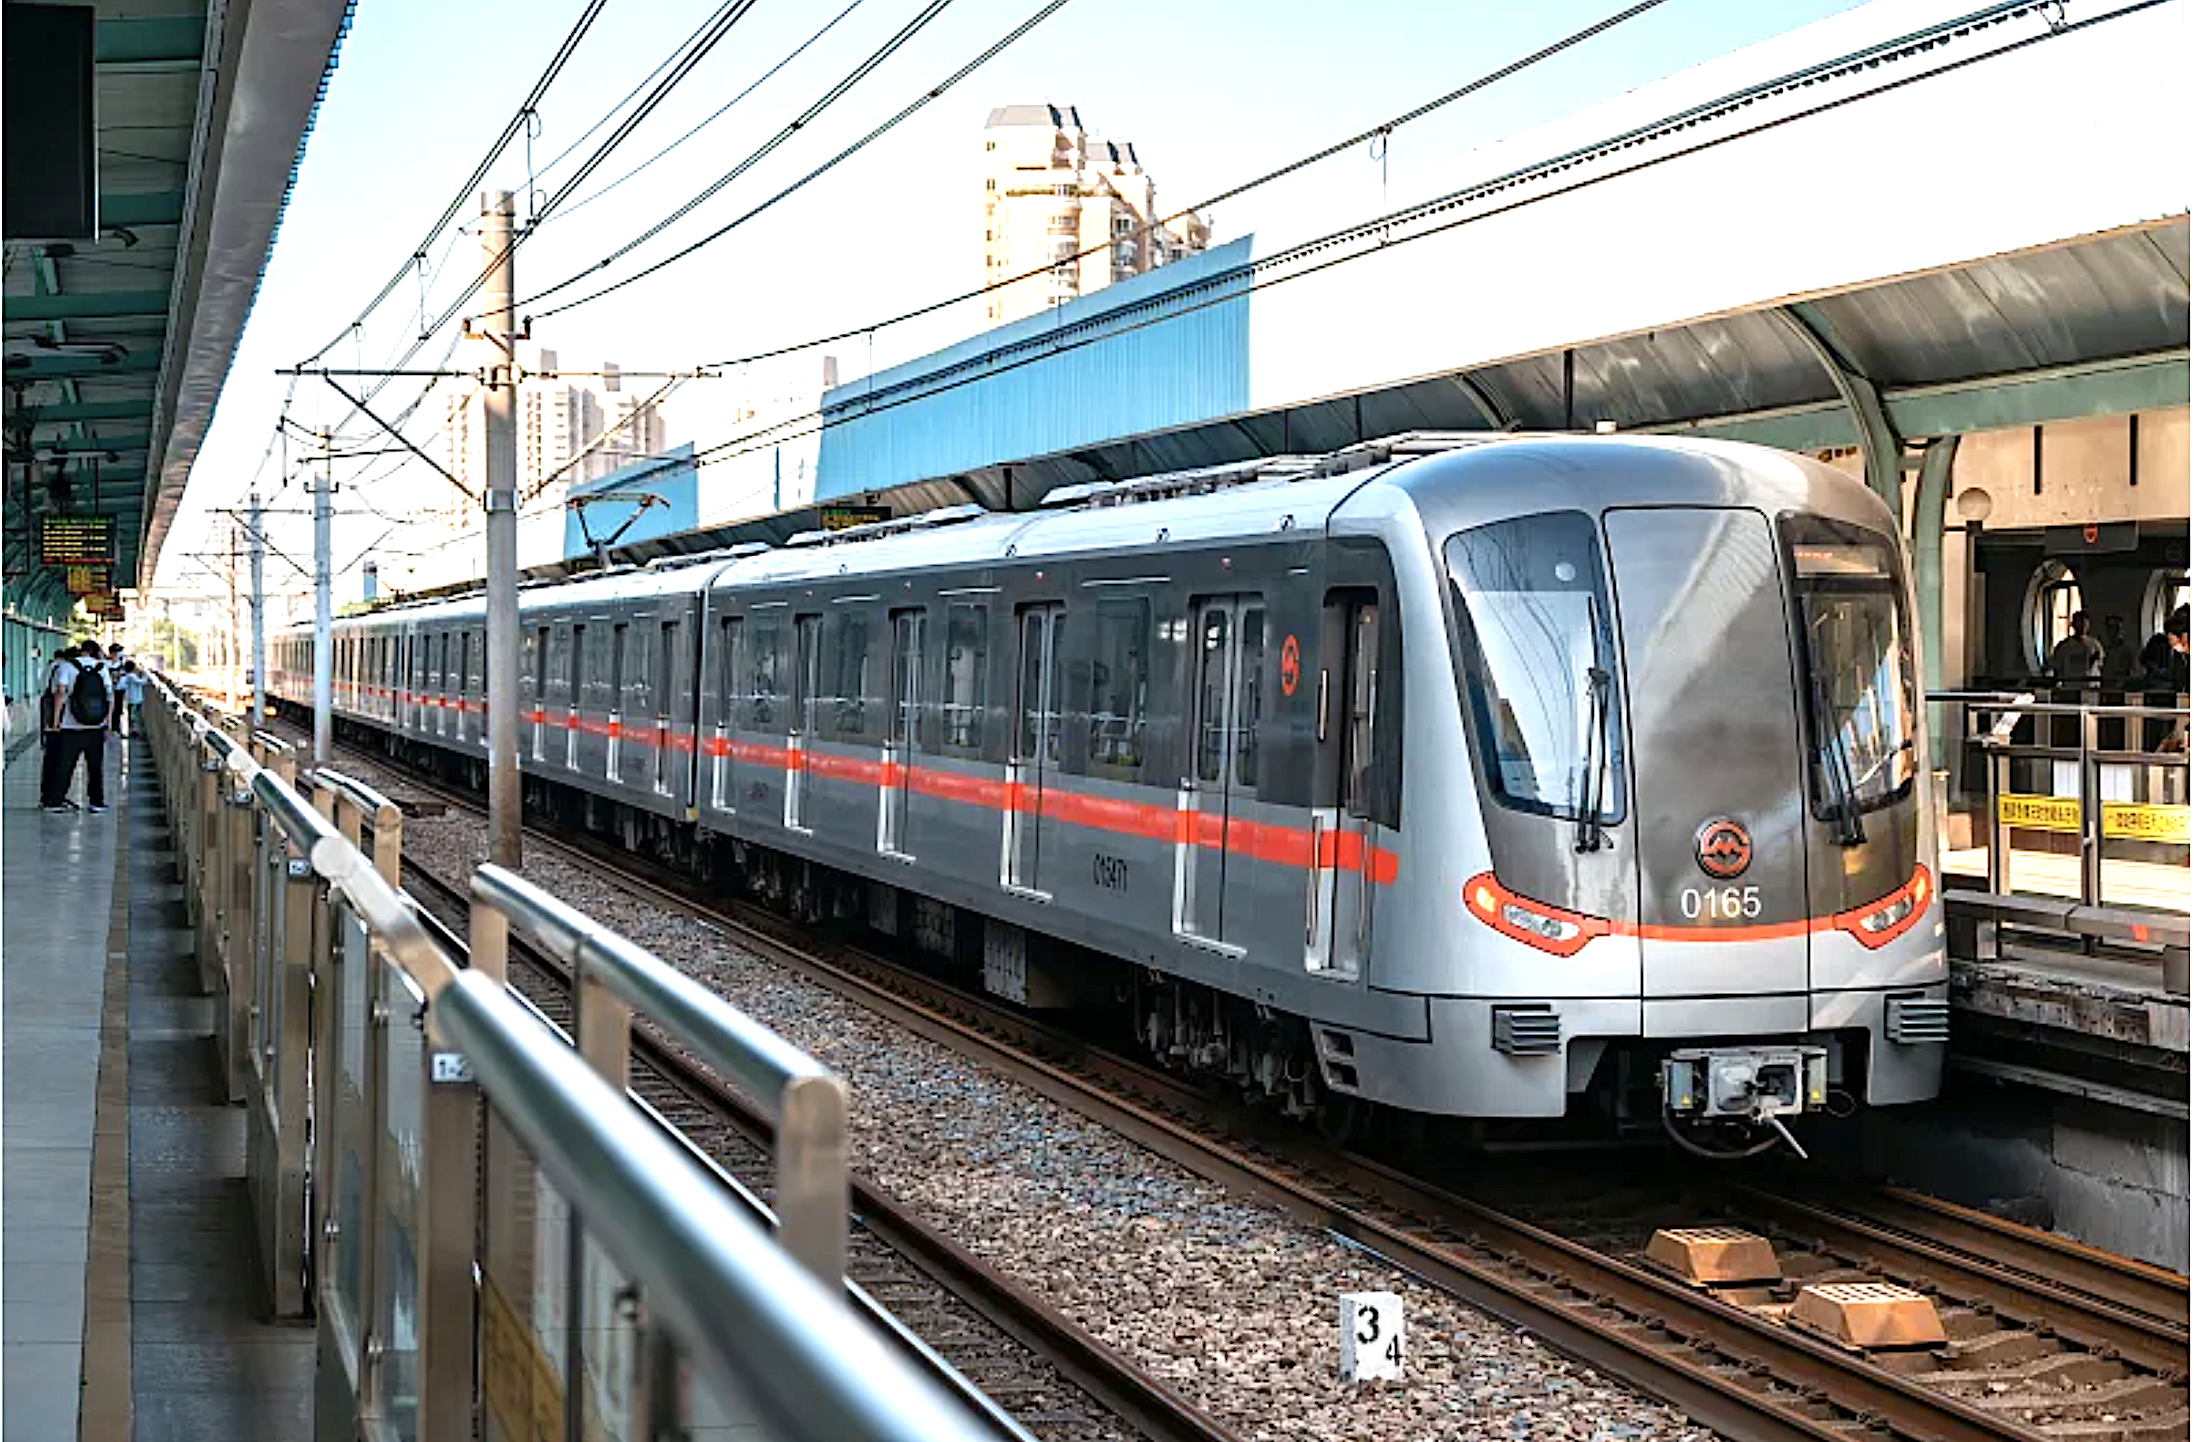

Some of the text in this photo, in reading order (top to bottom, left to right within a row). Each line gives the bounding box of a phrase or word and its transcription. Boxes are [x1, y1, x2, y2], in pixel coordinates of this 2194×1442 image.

[1680, 886, 1762, 919] 0165
[1357, 1305, 1380, 1344] 3
[1386, 1333, 1403, 1367] 4
